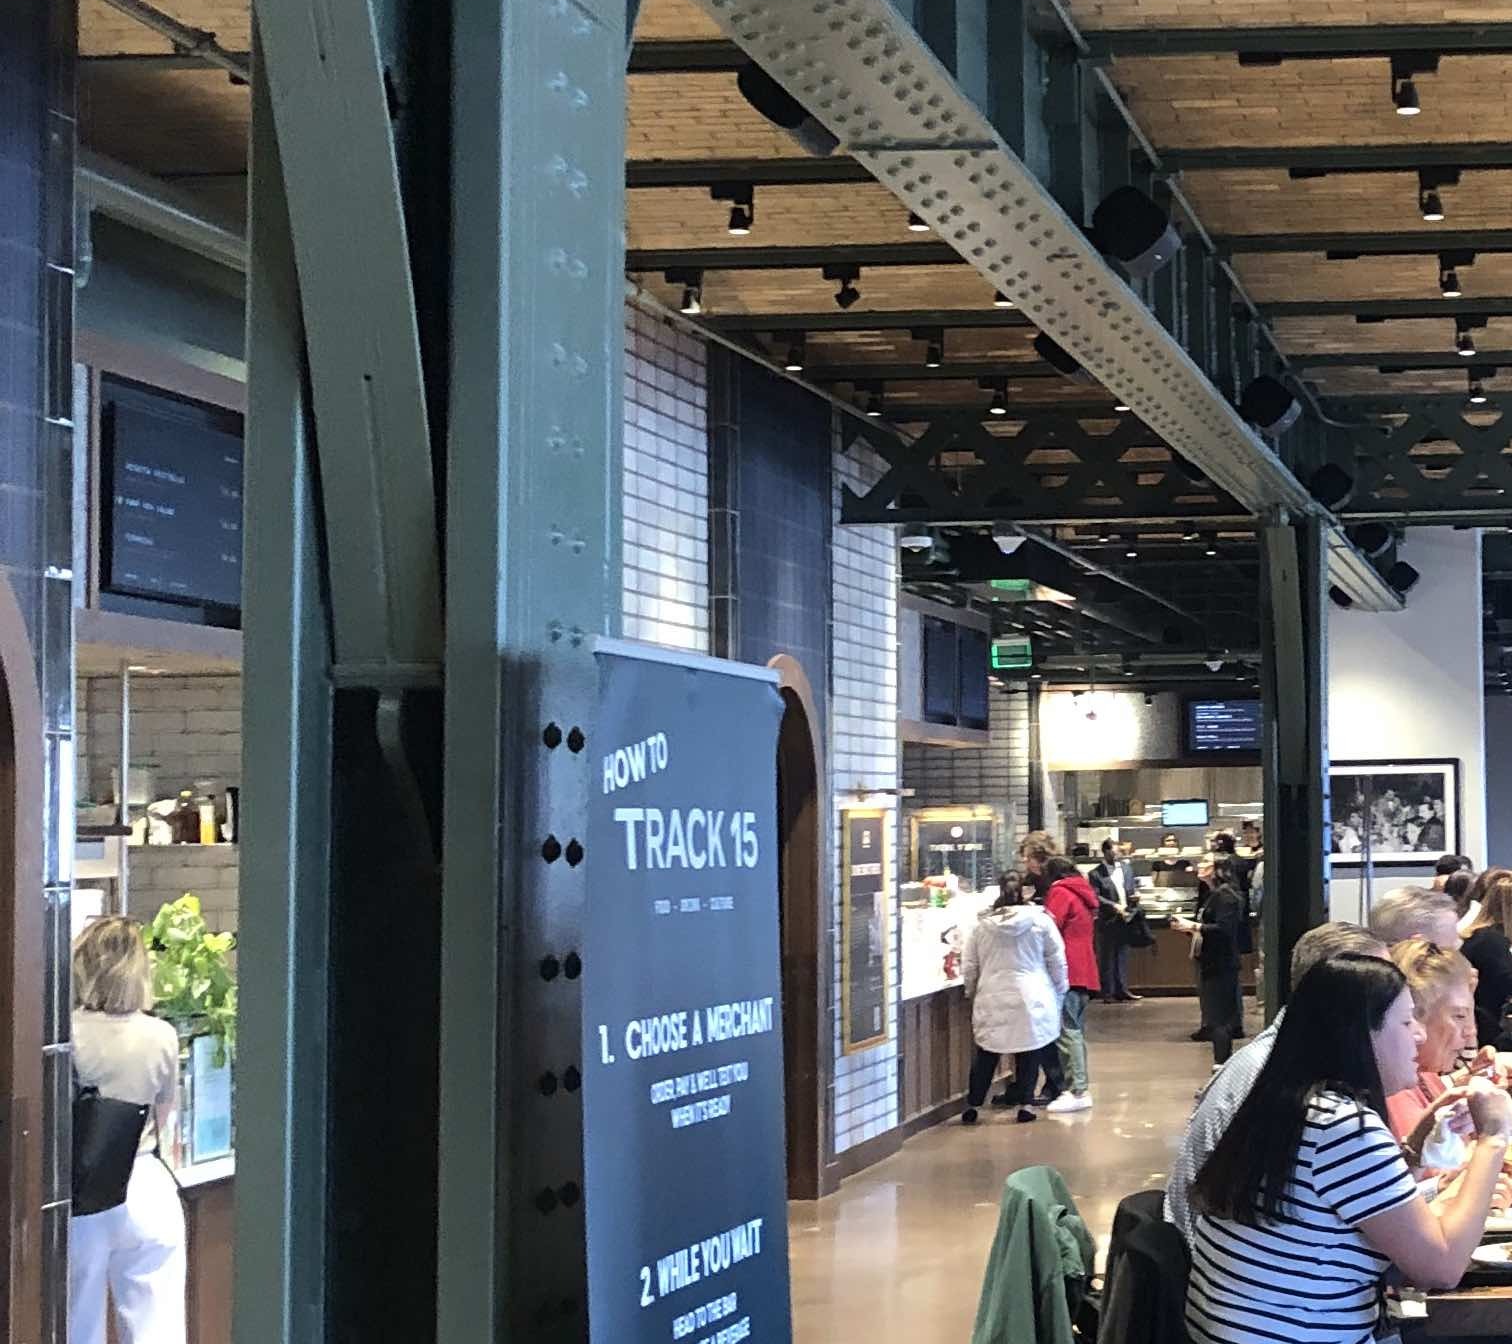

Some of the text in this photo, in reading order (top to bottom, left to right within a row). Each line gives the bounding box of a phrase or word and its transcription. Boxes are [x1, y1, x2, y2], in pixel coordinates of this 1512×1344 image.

[603, 732, 668, 794] HOW TO
[614, 808, 758, 870] TRACK 15
[599, 997, 773, 1064] 1. CHOOSE A MERCHANT
[657, 1244, 700, 1296] WHILE
[701, 1232, 730, 1276] YOU
[730, 1218, 762, 1263] WAIT
